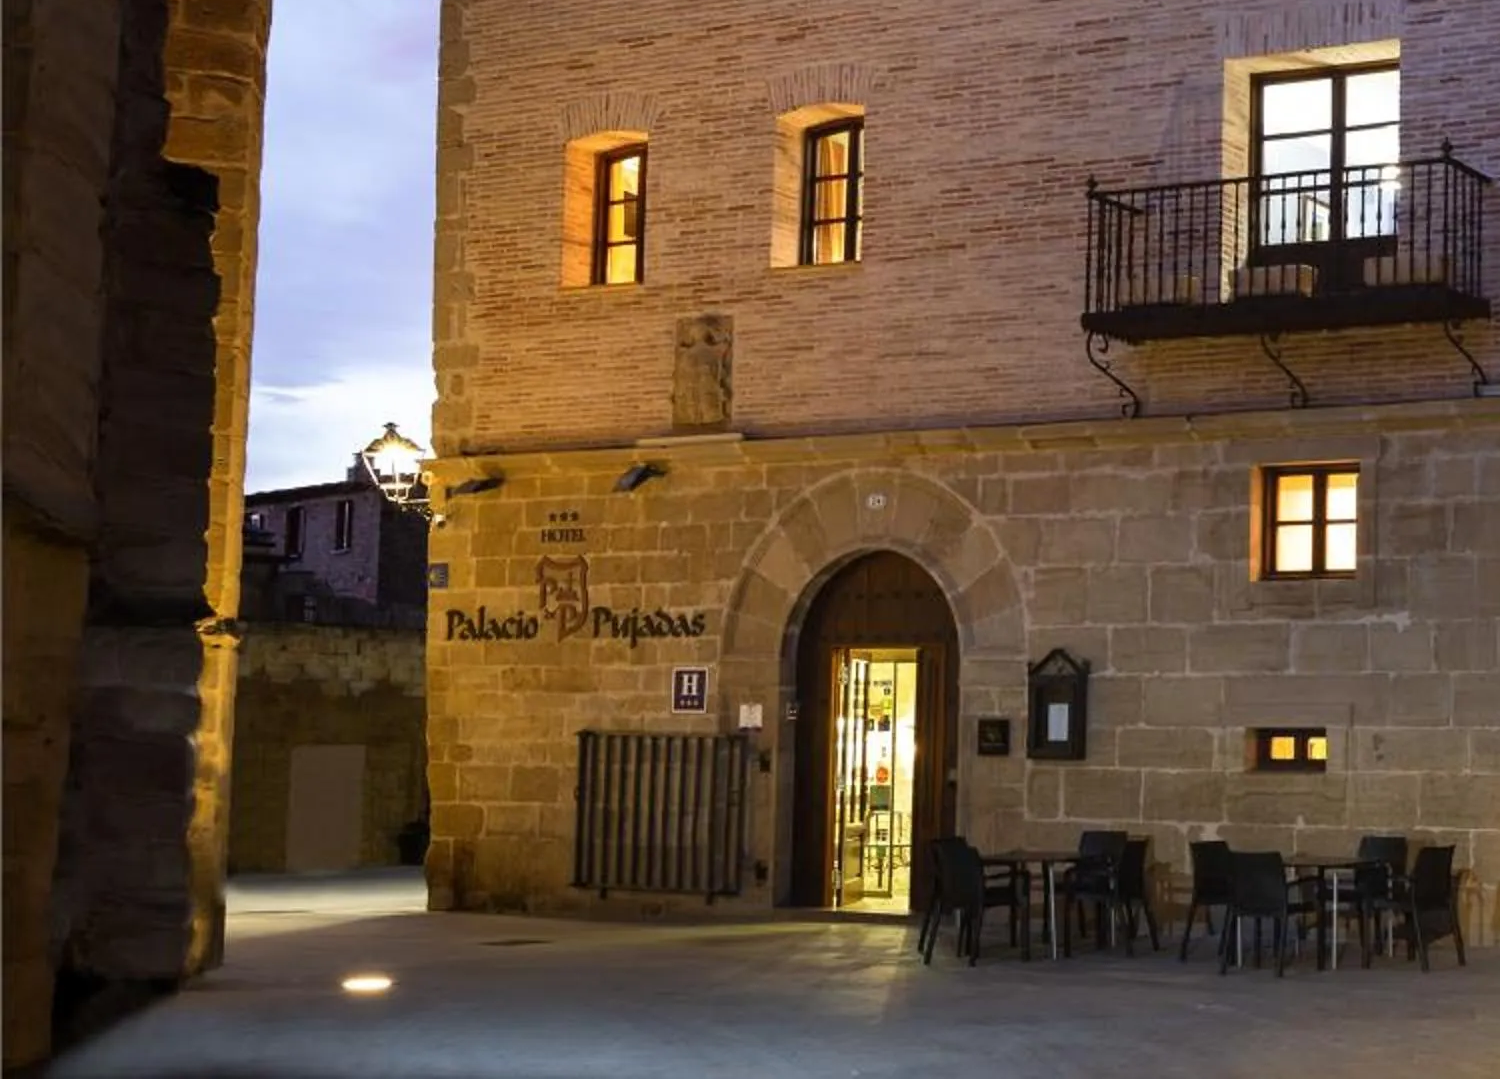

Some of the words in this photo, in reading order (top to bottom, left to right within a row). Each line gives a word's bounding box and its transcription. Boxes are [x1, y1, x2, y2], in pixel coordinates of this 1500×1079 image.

[541, 528, 587, 543] HOTEL
[445, 606, 539, 641] Palacio
[591, 606, 706, 649] Pujadas
[681, 673, 699, 696] H
